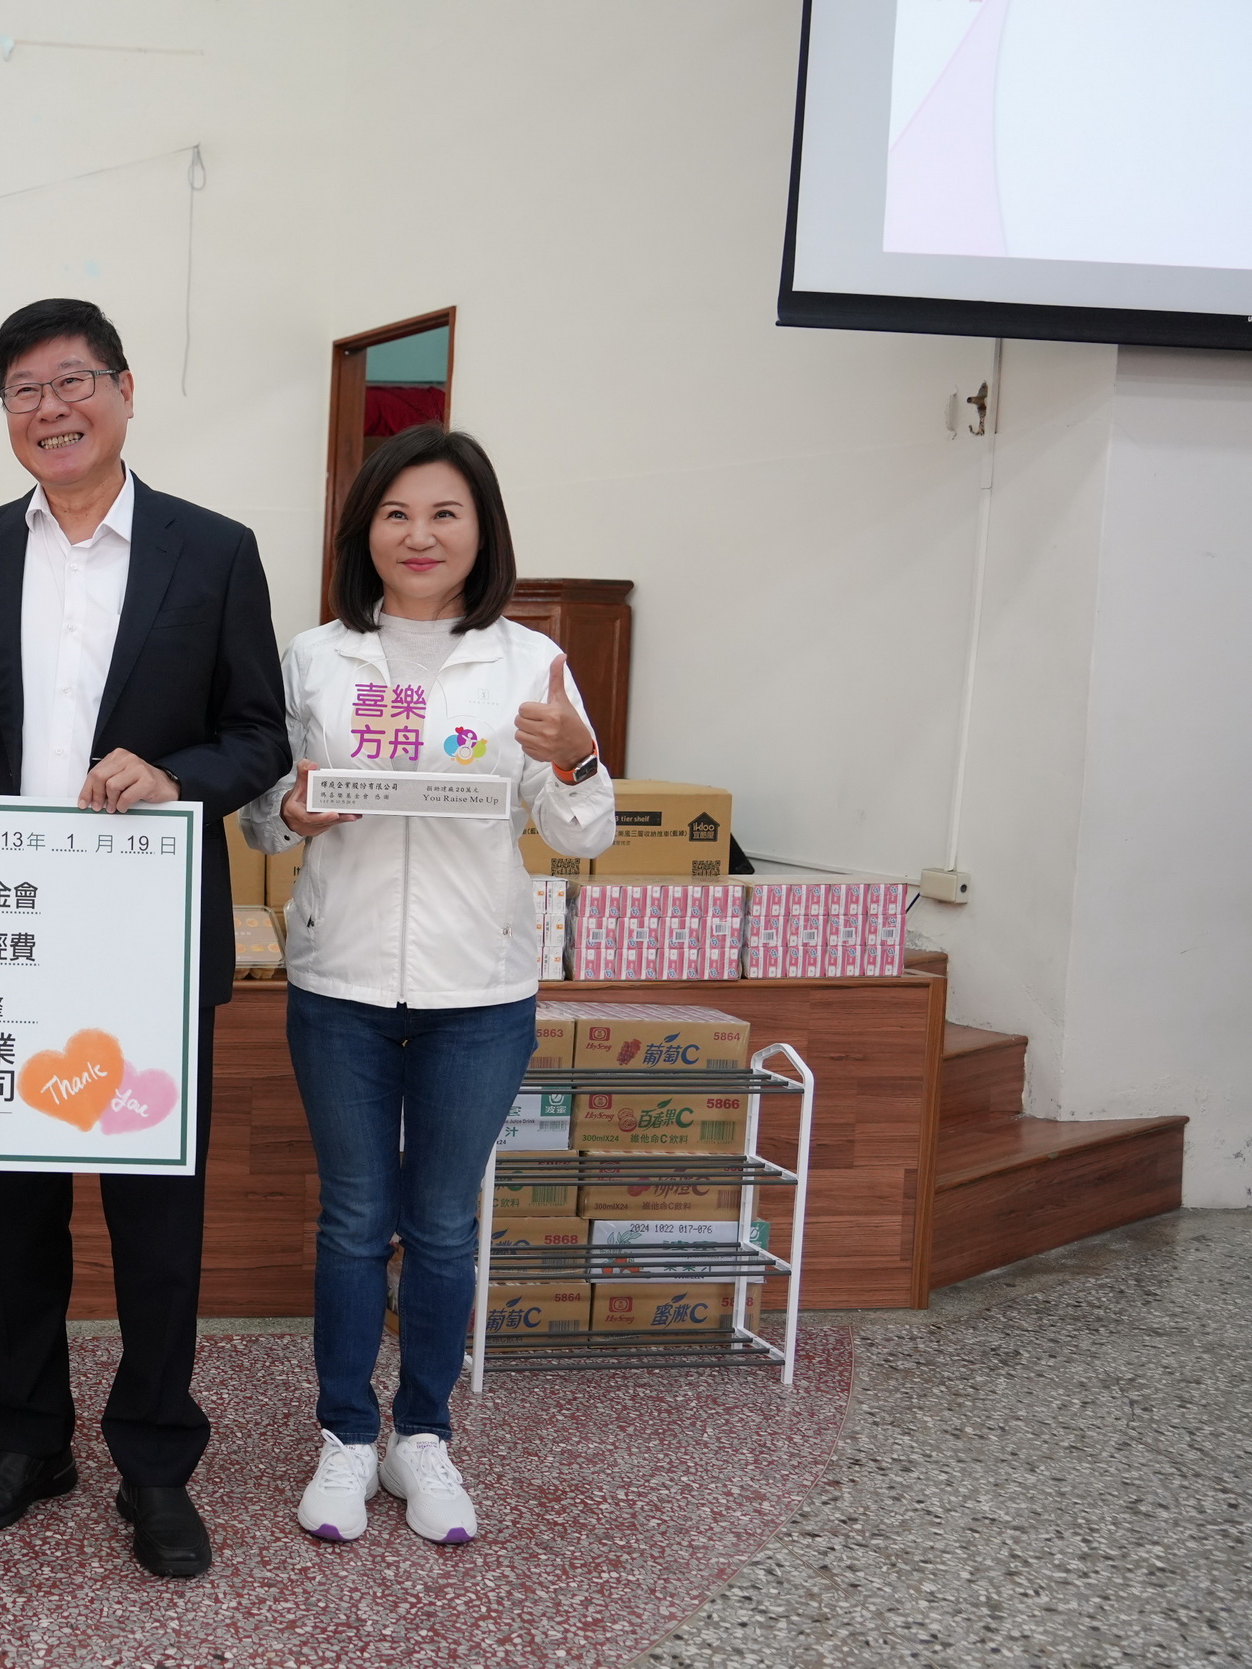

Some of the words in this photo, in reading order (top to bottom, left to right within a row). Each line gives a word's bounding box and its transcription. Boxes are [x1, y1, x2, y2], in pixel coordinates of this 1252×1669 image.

[352, 682, 427, 720] 喜樂
[350, 724, 425, 761] 方舟
[423, 794, 441, 802] You
[443, 795, 467, 803] Raise
[486, 796, 499, 805] Up
[692, 822, 715, 831] ikloo
[536, 1028, 564, 1038] 5863
[713, 1031, 741, 1041] 5864
[643, 1043, 701, 1067] 葡萄C
[40, 1061, 108, 1106] Thank
[545, 1105, 567, 1114] 波蜜
[706, 1098, 740, 1110] 5866
[638, 1106, 694, 1130] 百香果C
[505, 1126, 519, 1137] 汁
[629, 1223, 650, 1233] 2024
[654, 1224, 674, 1233] 1022
[678, 1224, 713, 1234] 017-076
[544, 1234, 578, 1245] 5868
[554, 1293, 581, 1302] 5864
[721, 1296, 754, 1307] 588
[485, 1306, 542, 1333] 葡萄C
[650, 1302, 709, 1328] 蜜桃C
